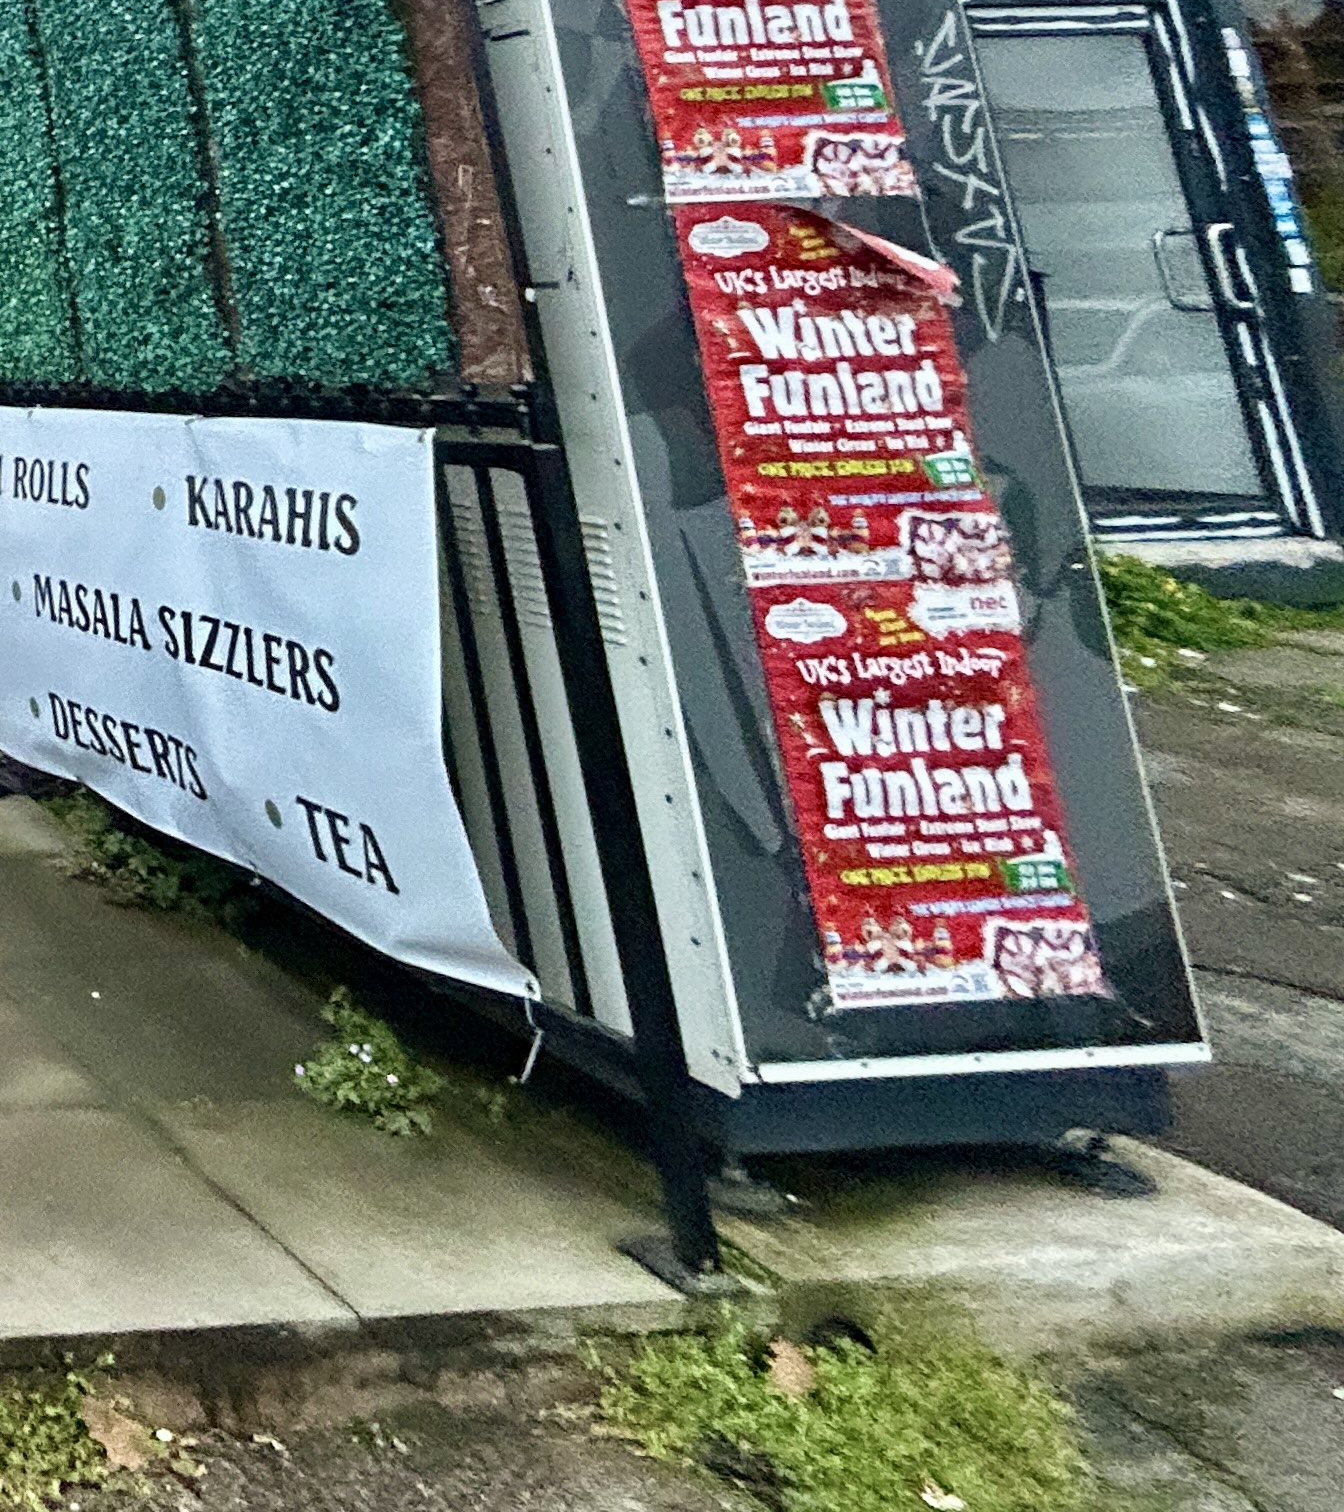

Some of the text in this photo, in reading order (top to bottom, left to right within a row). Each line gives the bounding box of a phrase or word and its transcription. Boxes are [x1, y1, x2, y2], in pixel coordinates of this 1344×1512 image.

[714, 268, 768, 295] UK's
[769, 265, 846, 296] Largest
[736, 298, 916, 361] Winter
[739, 359, 943, 417] Funland
[13, 456, 90, 510] ROLLS
[185, 475, 360, 555] KARAHIS
[34, 574, 340, 713] MASALA SIZZLERS
[796, 647, 1007, 686] UK's Largest Indoor
[48, 692, 208, 801] DESSERTS
[817, 687, 1006, 757] Winter
[819, 753, 1033, 819] Funland
[295, 794, 400, 896] TEA
